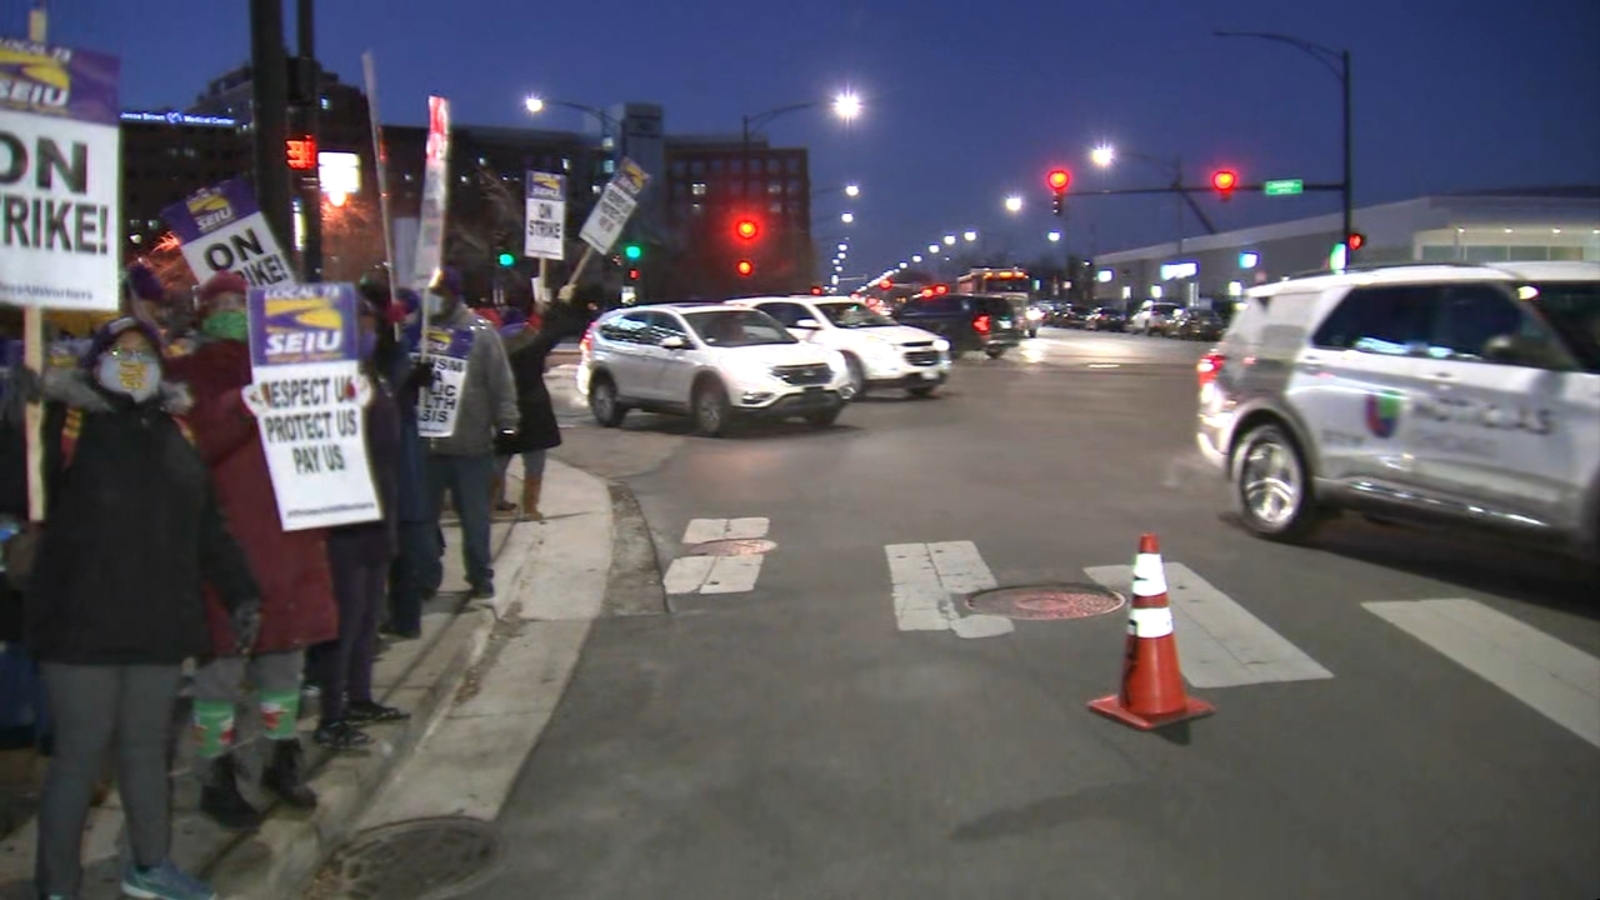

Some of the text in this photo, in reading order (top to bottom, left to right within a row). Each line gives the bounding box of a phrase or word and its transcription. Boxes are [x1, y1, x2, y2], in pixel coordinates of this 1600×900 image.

[143, 112, 165, 121] Brown
[184, 115, 210, 123] Medical
[210, 116, 235, 125] Center
[0, 130, 88, 195] ON
[0, 193, 108, 256] RIKE!
[195, 206, 233, 231] SEIU
[204, 227, 264, 272] ON
[234, 253, 289, 287] IKE!
[264, 329, 341, 355] SEIU
[264, 409, 358, 443] PROTECT US
[293, 444, 346, 475] PAY US
